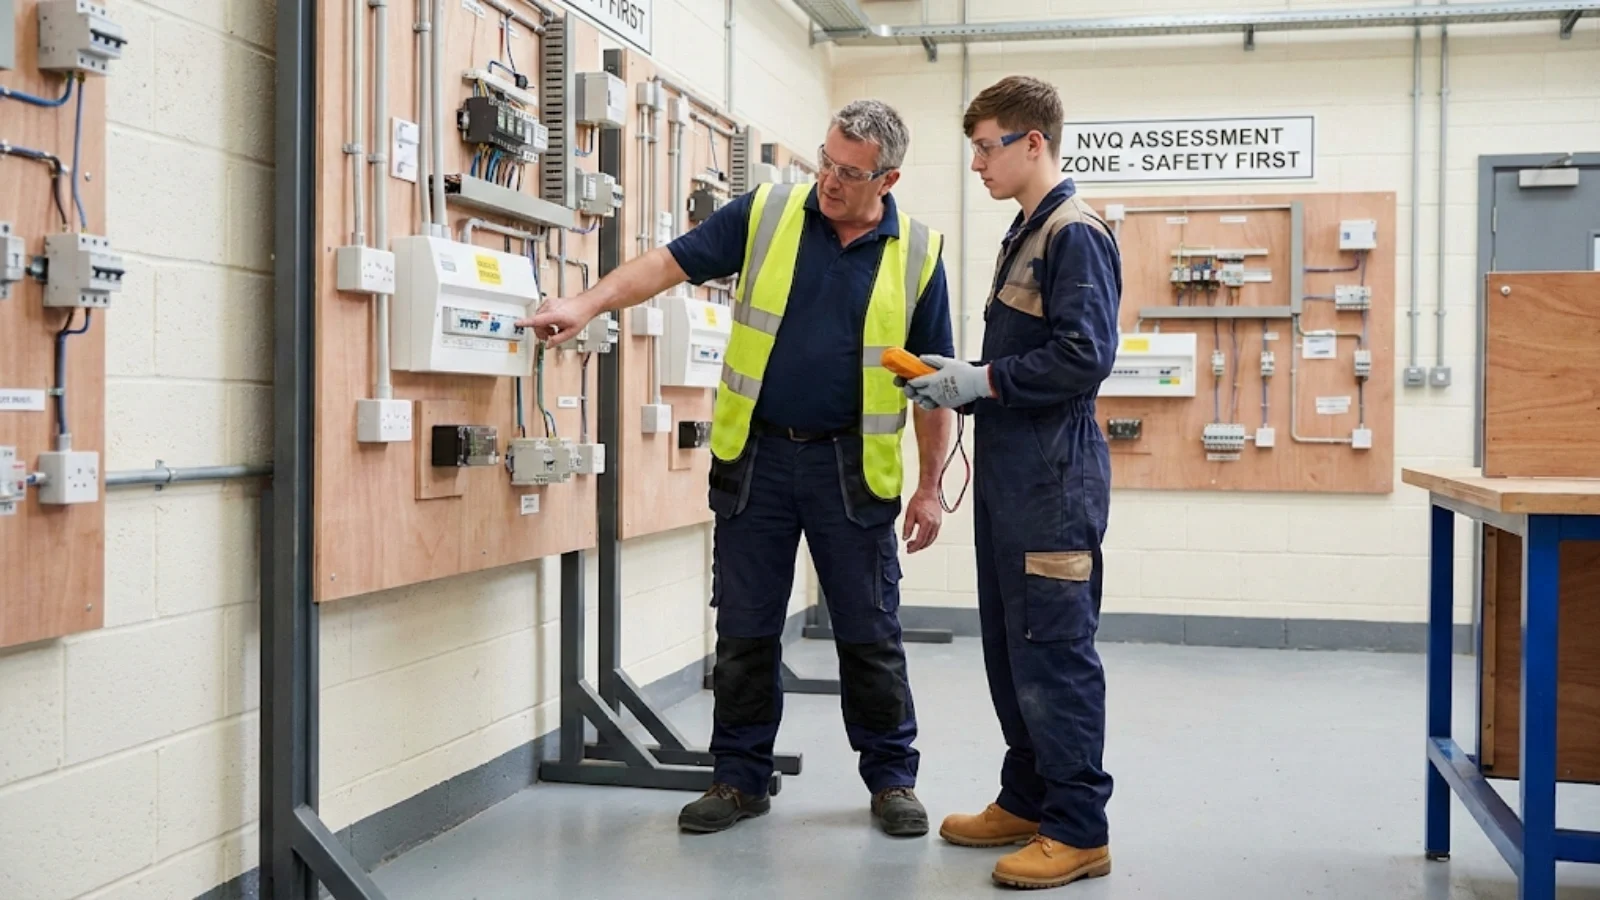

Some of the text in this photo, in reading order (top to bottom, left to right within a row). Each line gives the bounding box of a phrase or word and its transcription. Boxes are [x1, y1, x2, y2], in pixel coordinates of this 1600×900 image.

[609, 0, 645, 34] FIRST
[1077, 128, 1284, 149] NVQ ASSESSMENT
[1061, 155, 1120, 173] ZONE
[1142, 152, 1229, 171] SAFETY
[1236, 150, 1301, 169] FIRST
